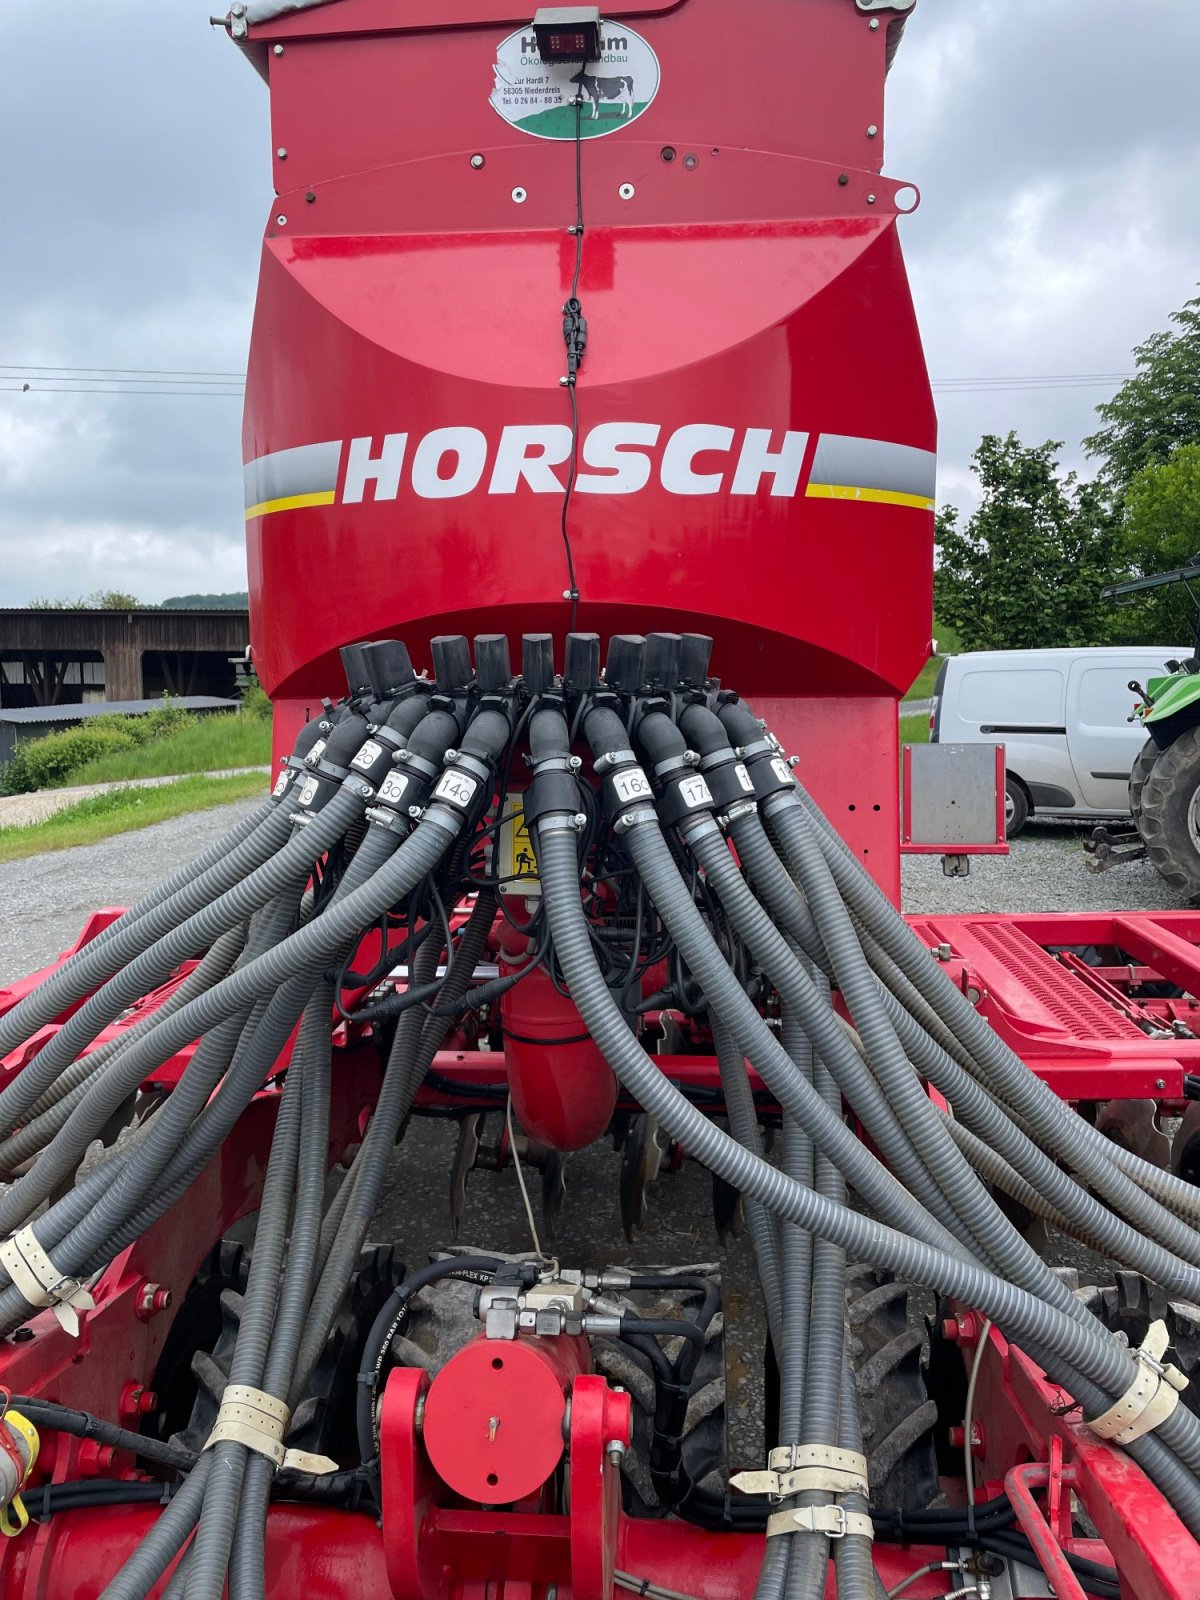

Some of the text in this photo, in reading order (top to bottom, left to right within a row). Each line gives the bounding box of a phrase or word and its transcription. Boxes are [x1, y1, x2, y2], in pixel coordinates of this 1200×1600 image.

[545, 76, 550, 84] 7
[503, 86, 561, 95] 56305 Niederdreis
[502, 97, 512, 105] Tel.
[544, 96, 553, 104] 80
[342, 421, 811, 504] HORSCH
